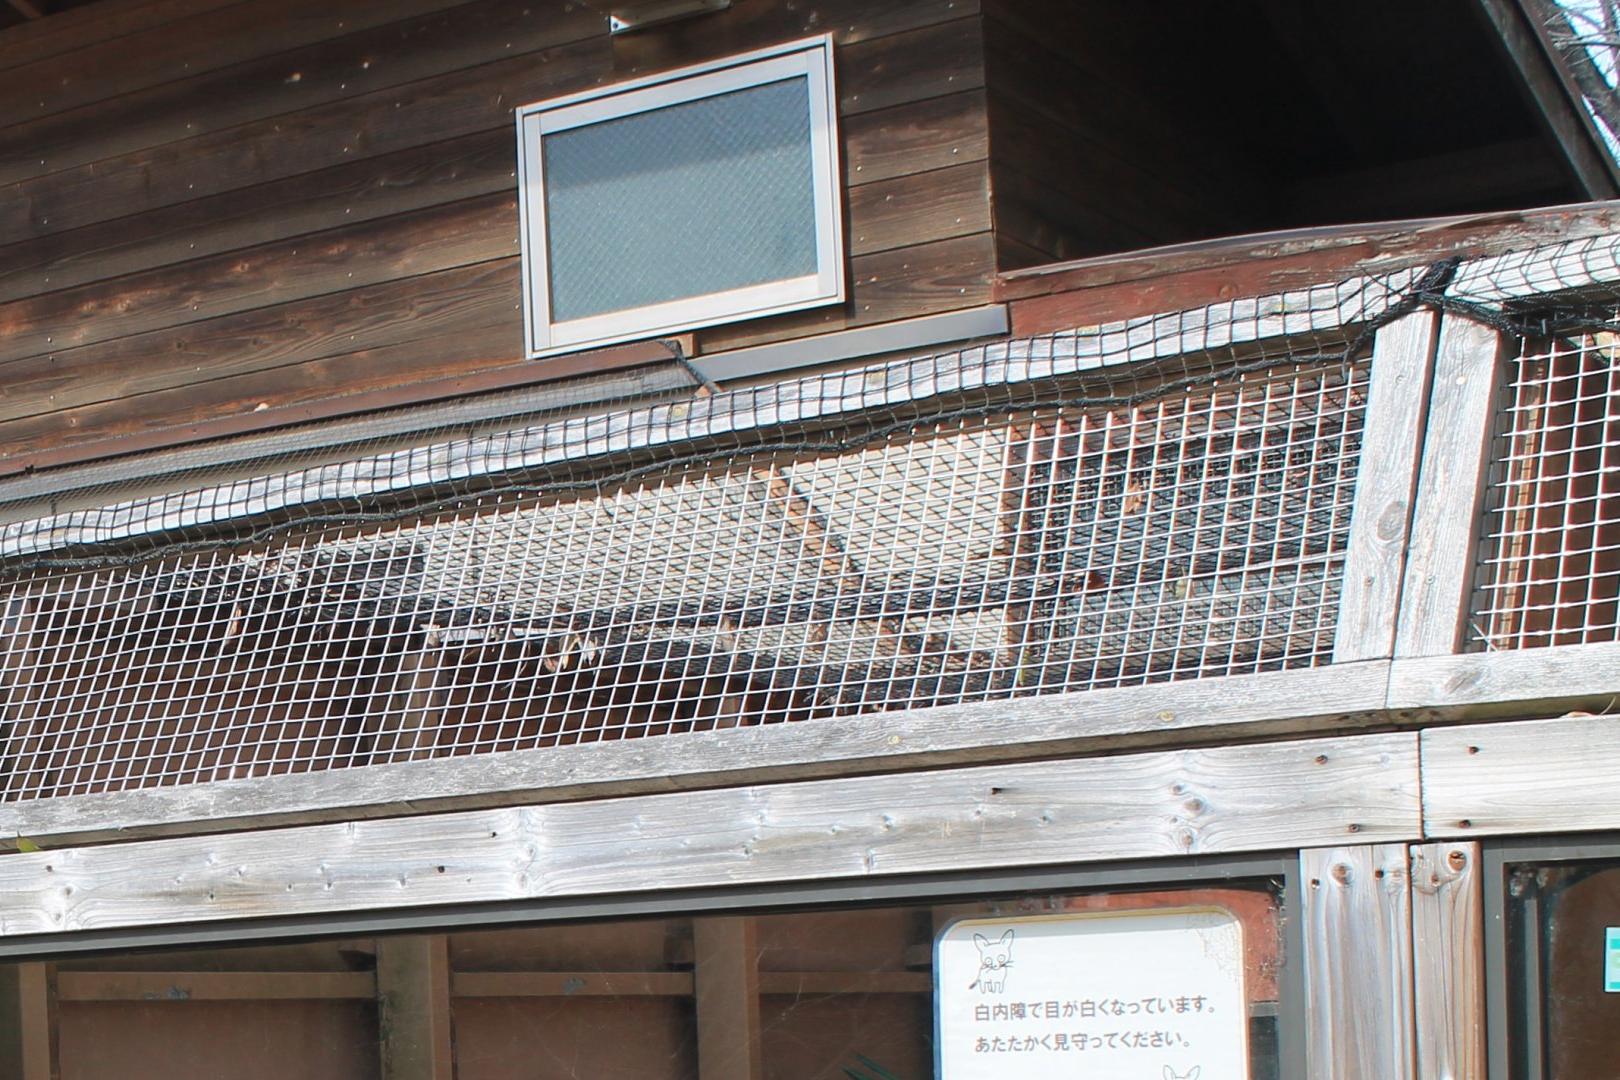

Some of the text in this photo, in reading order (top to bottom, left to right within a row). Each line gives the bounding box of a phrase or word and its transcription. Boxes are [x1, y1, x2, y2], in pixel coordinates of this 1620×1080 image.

[974, 995, 1215, 1022] 白内障で目が白くなっています。
[974, 1030, 1190, 1053] あたたかく見守ってください。
